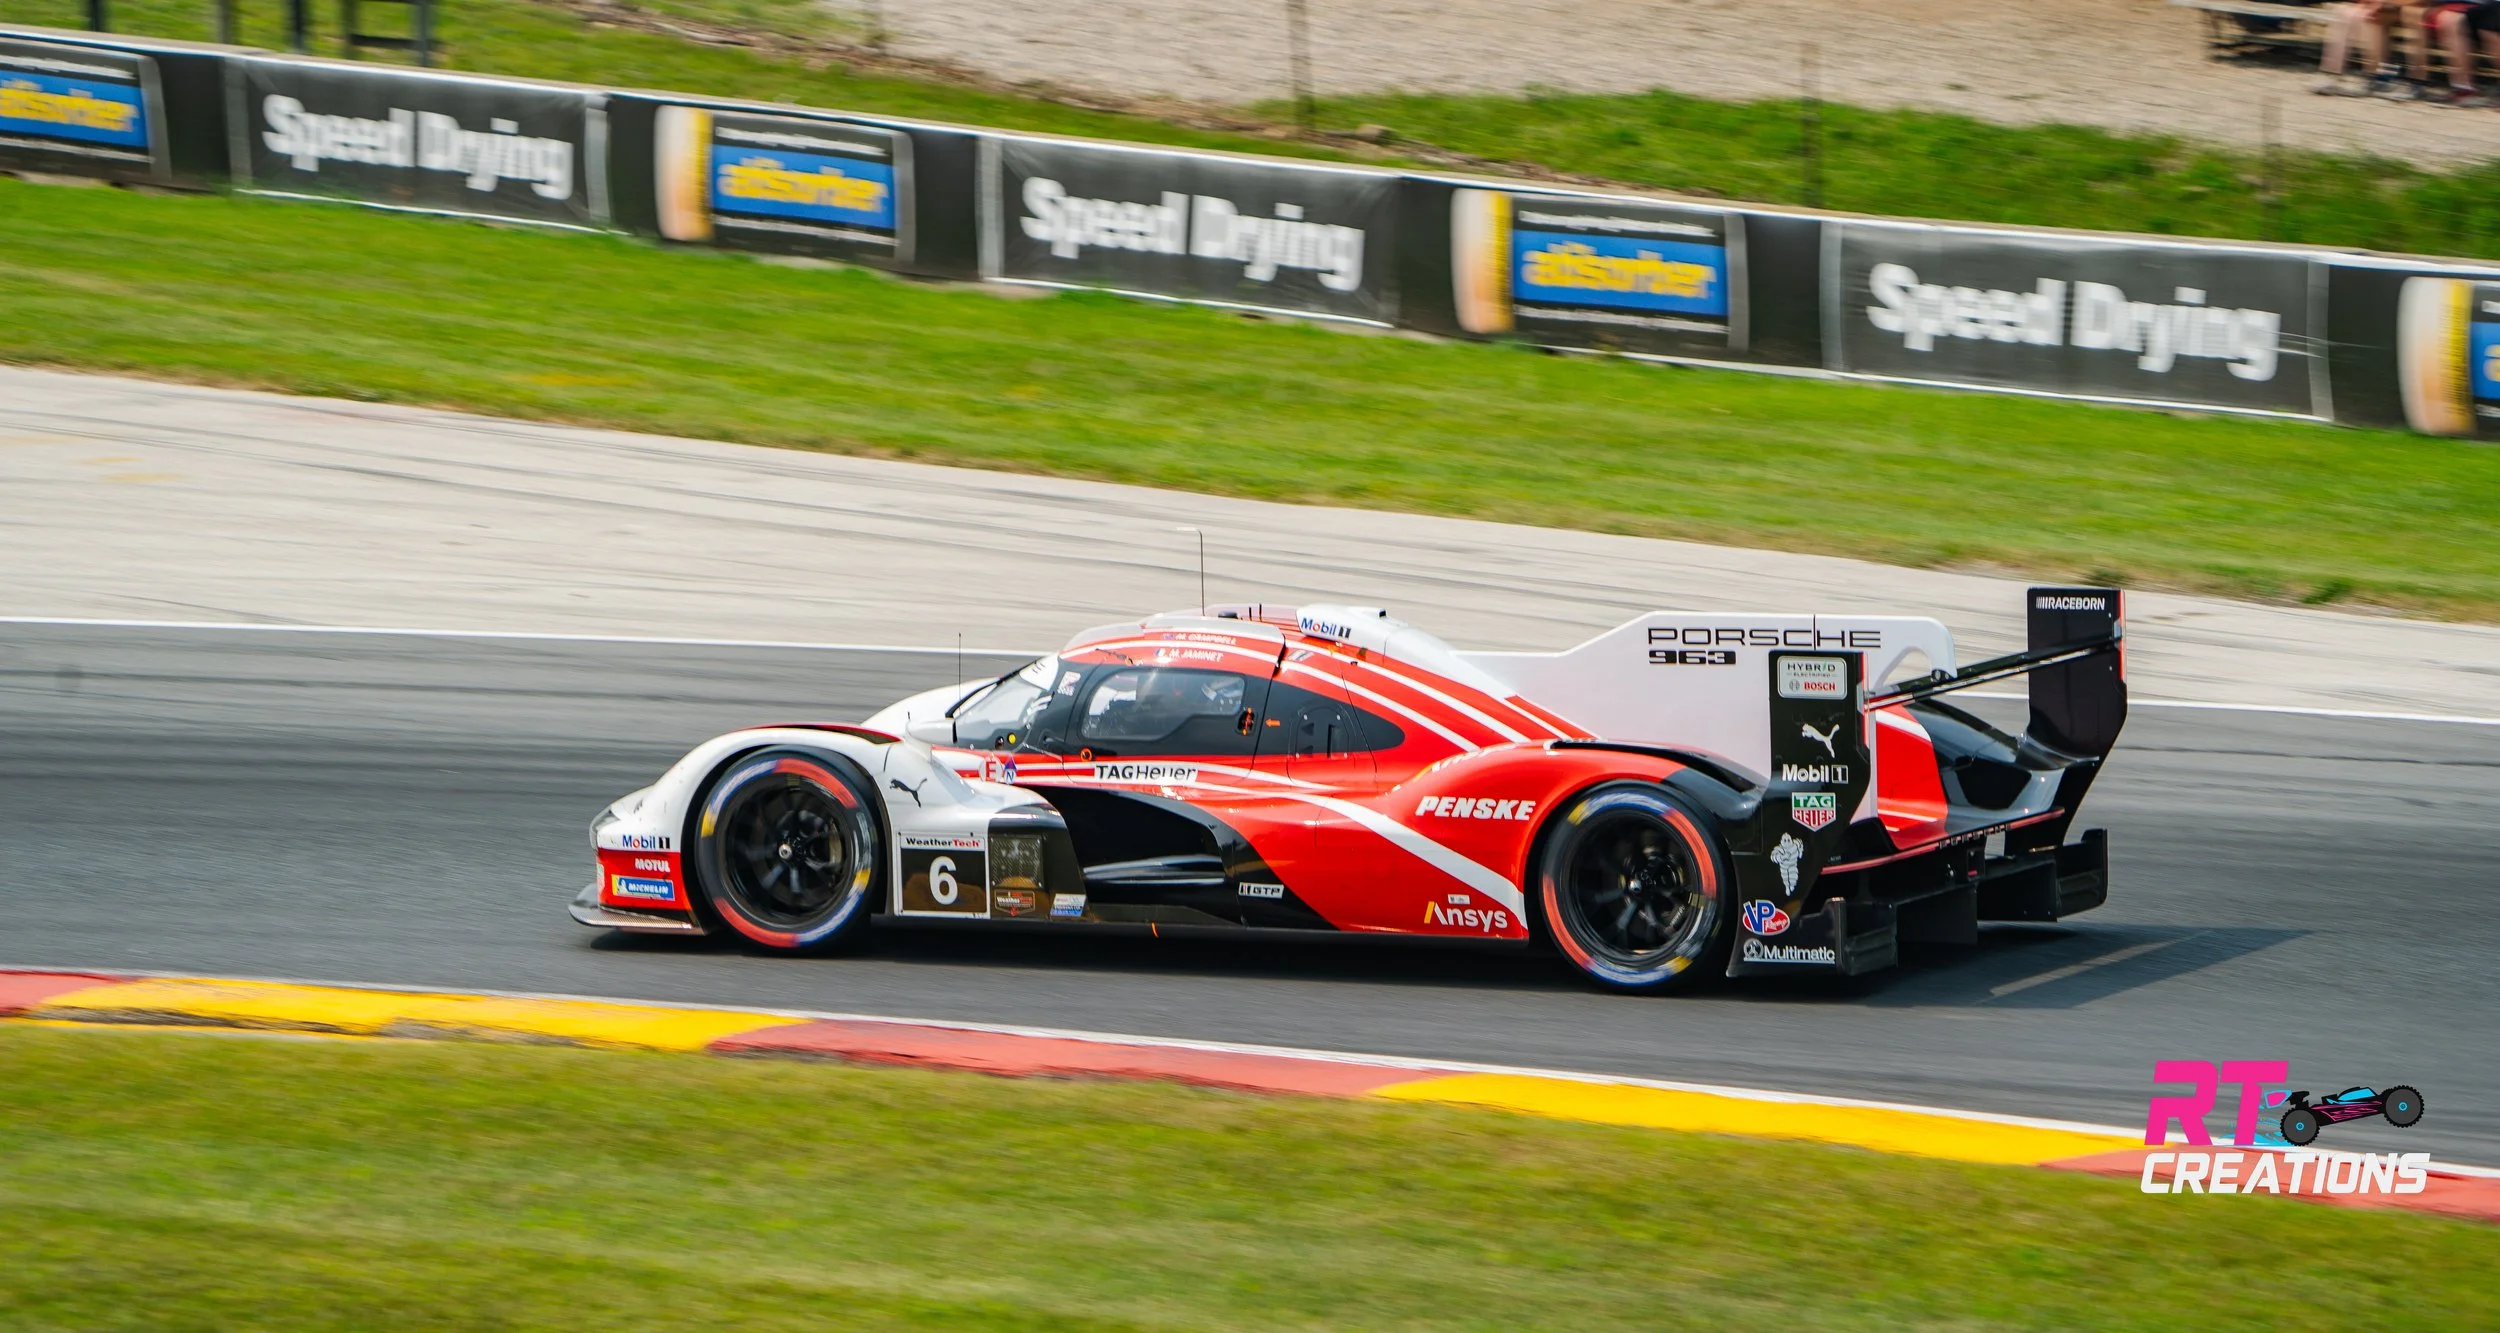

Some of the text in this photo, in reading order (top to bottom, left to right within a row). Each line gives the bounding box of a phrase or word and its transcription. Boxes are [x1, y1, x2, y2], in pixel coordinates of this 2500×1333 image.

[261, 93, 574, 200] Speed Drying
[1020, 176, 1365, 291] Speed Drying
[1866, 262, 2281, 381] Speed Drying
[2047, 596, 2105, 610] RACEBORN
[1300, 616, 1337, 636] Mobil
[1648, 627, 1881, 648] PORSCHE
[1181, 648, 1224, 662] JAMINET
[1649, 650, 1736, 665] 963
[1804, 682, 1836, 691] BOSCH
[1782, 764, 1830, 783] Mobil
[1415, 796, 1536, 821] PENSKE
[1795, 795, 1834, 808] TAG
[1794, 809, 1835, 829] HEUER
[622, 835, 656, 849] Mobil
[635, 858, 670, 872] MOTUL
[628, 883, 668, 894] MICHELIN
[929, 856, 958, 905] 6
[1250, 887, 1281, 896] GTP
[1424, 901, 1508, 932] Ansys
[1743, 900, 1776, 934] VP
[1764, 945, 1835, 960] Multimatic
